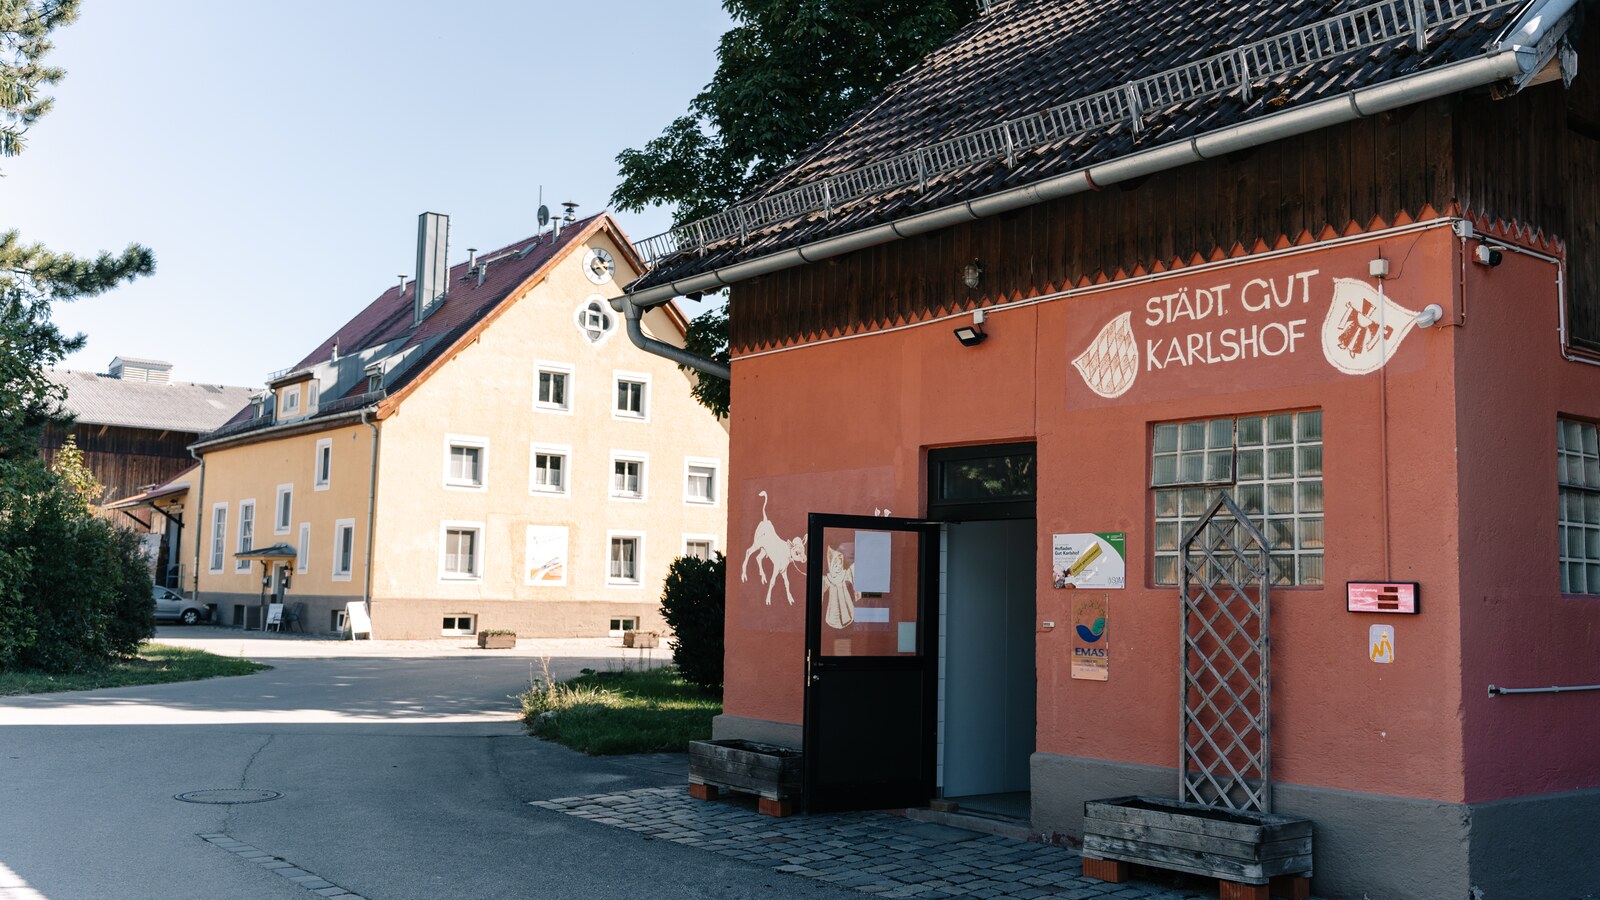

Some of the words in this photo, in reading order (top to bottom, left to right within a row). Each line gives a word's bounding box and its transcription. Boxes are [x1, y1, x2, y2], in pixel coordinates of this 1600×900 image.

[1241, 269, 1320, 312] GUT
[1146, 319, 1307, 372] KARLSHOF
[1075, 647, 1105, 657] EMAS
